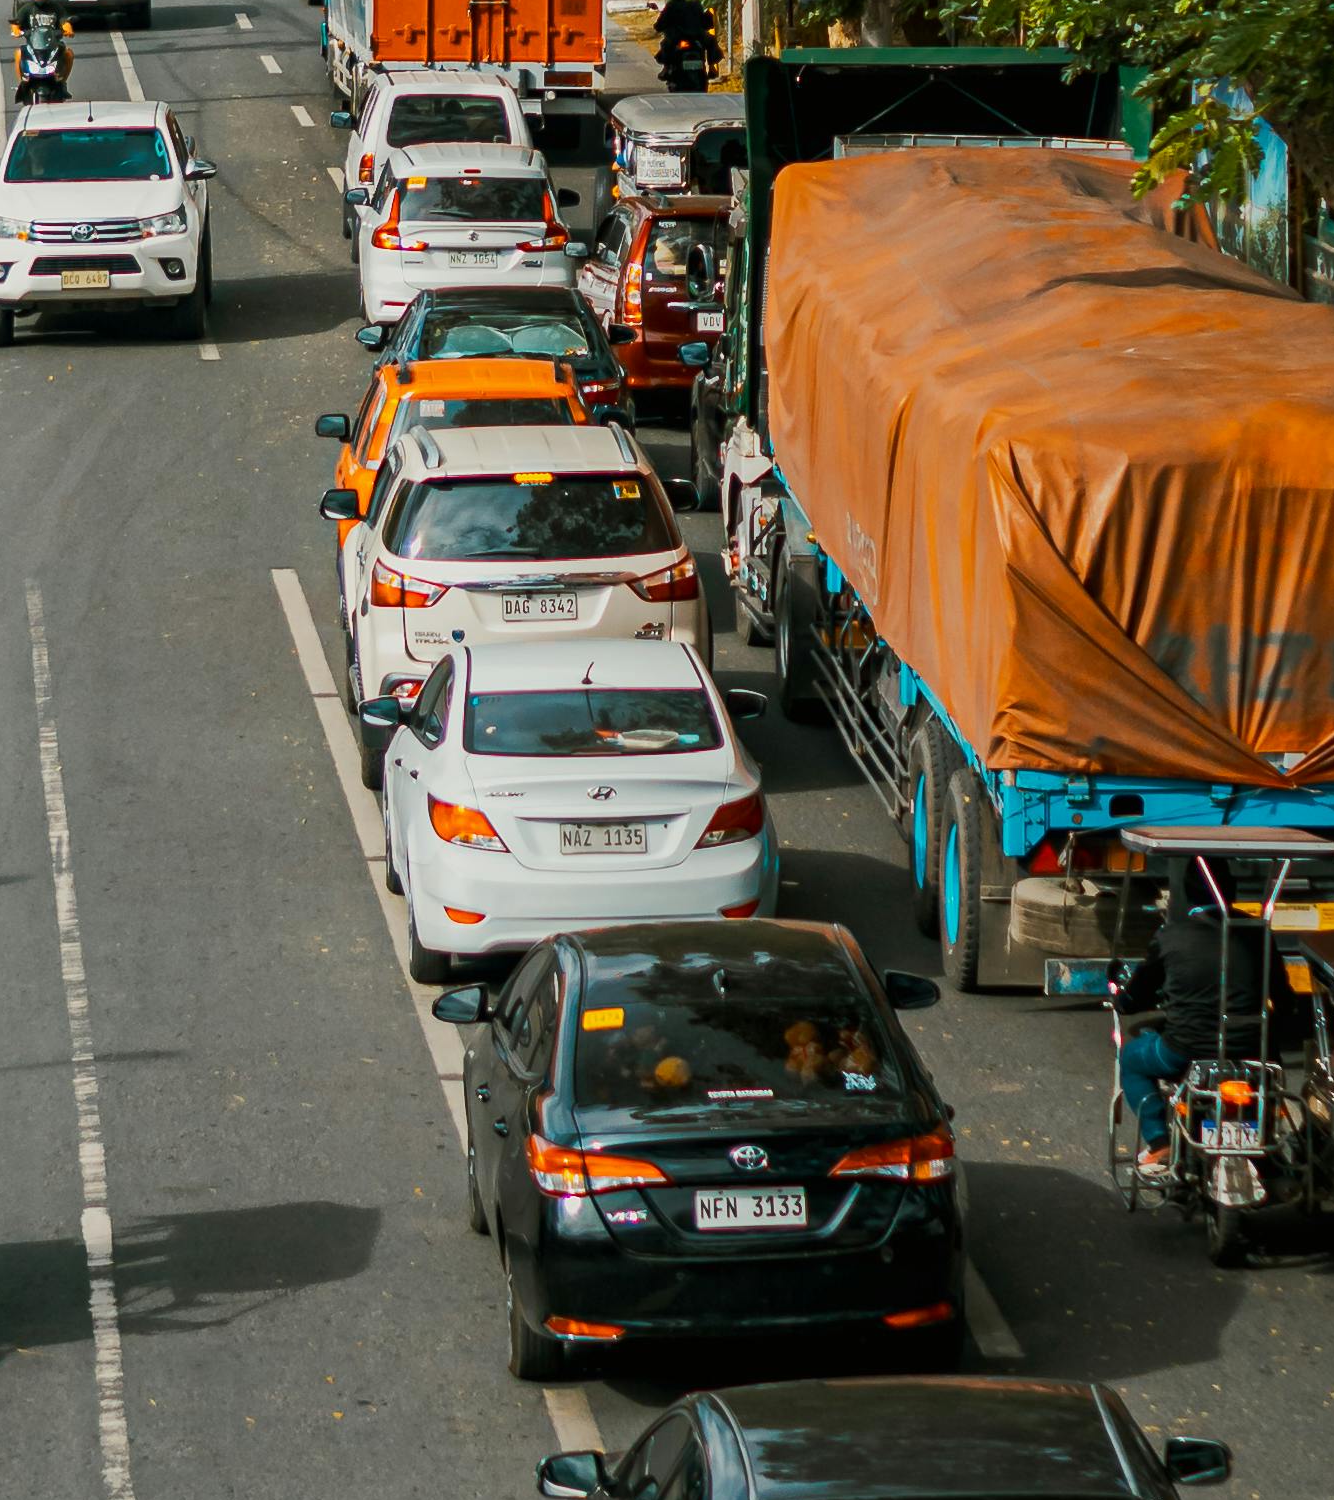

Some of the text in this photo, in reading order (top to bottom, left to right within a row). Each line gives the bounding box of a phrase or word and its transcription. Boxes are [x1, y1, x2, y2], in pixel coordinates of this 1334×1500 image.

[504, 598, 575, 615] DAG 8342
[561, 828, 644, 847] NAZ 1135
[699, 1194, 803, 1219] NFN 3133
